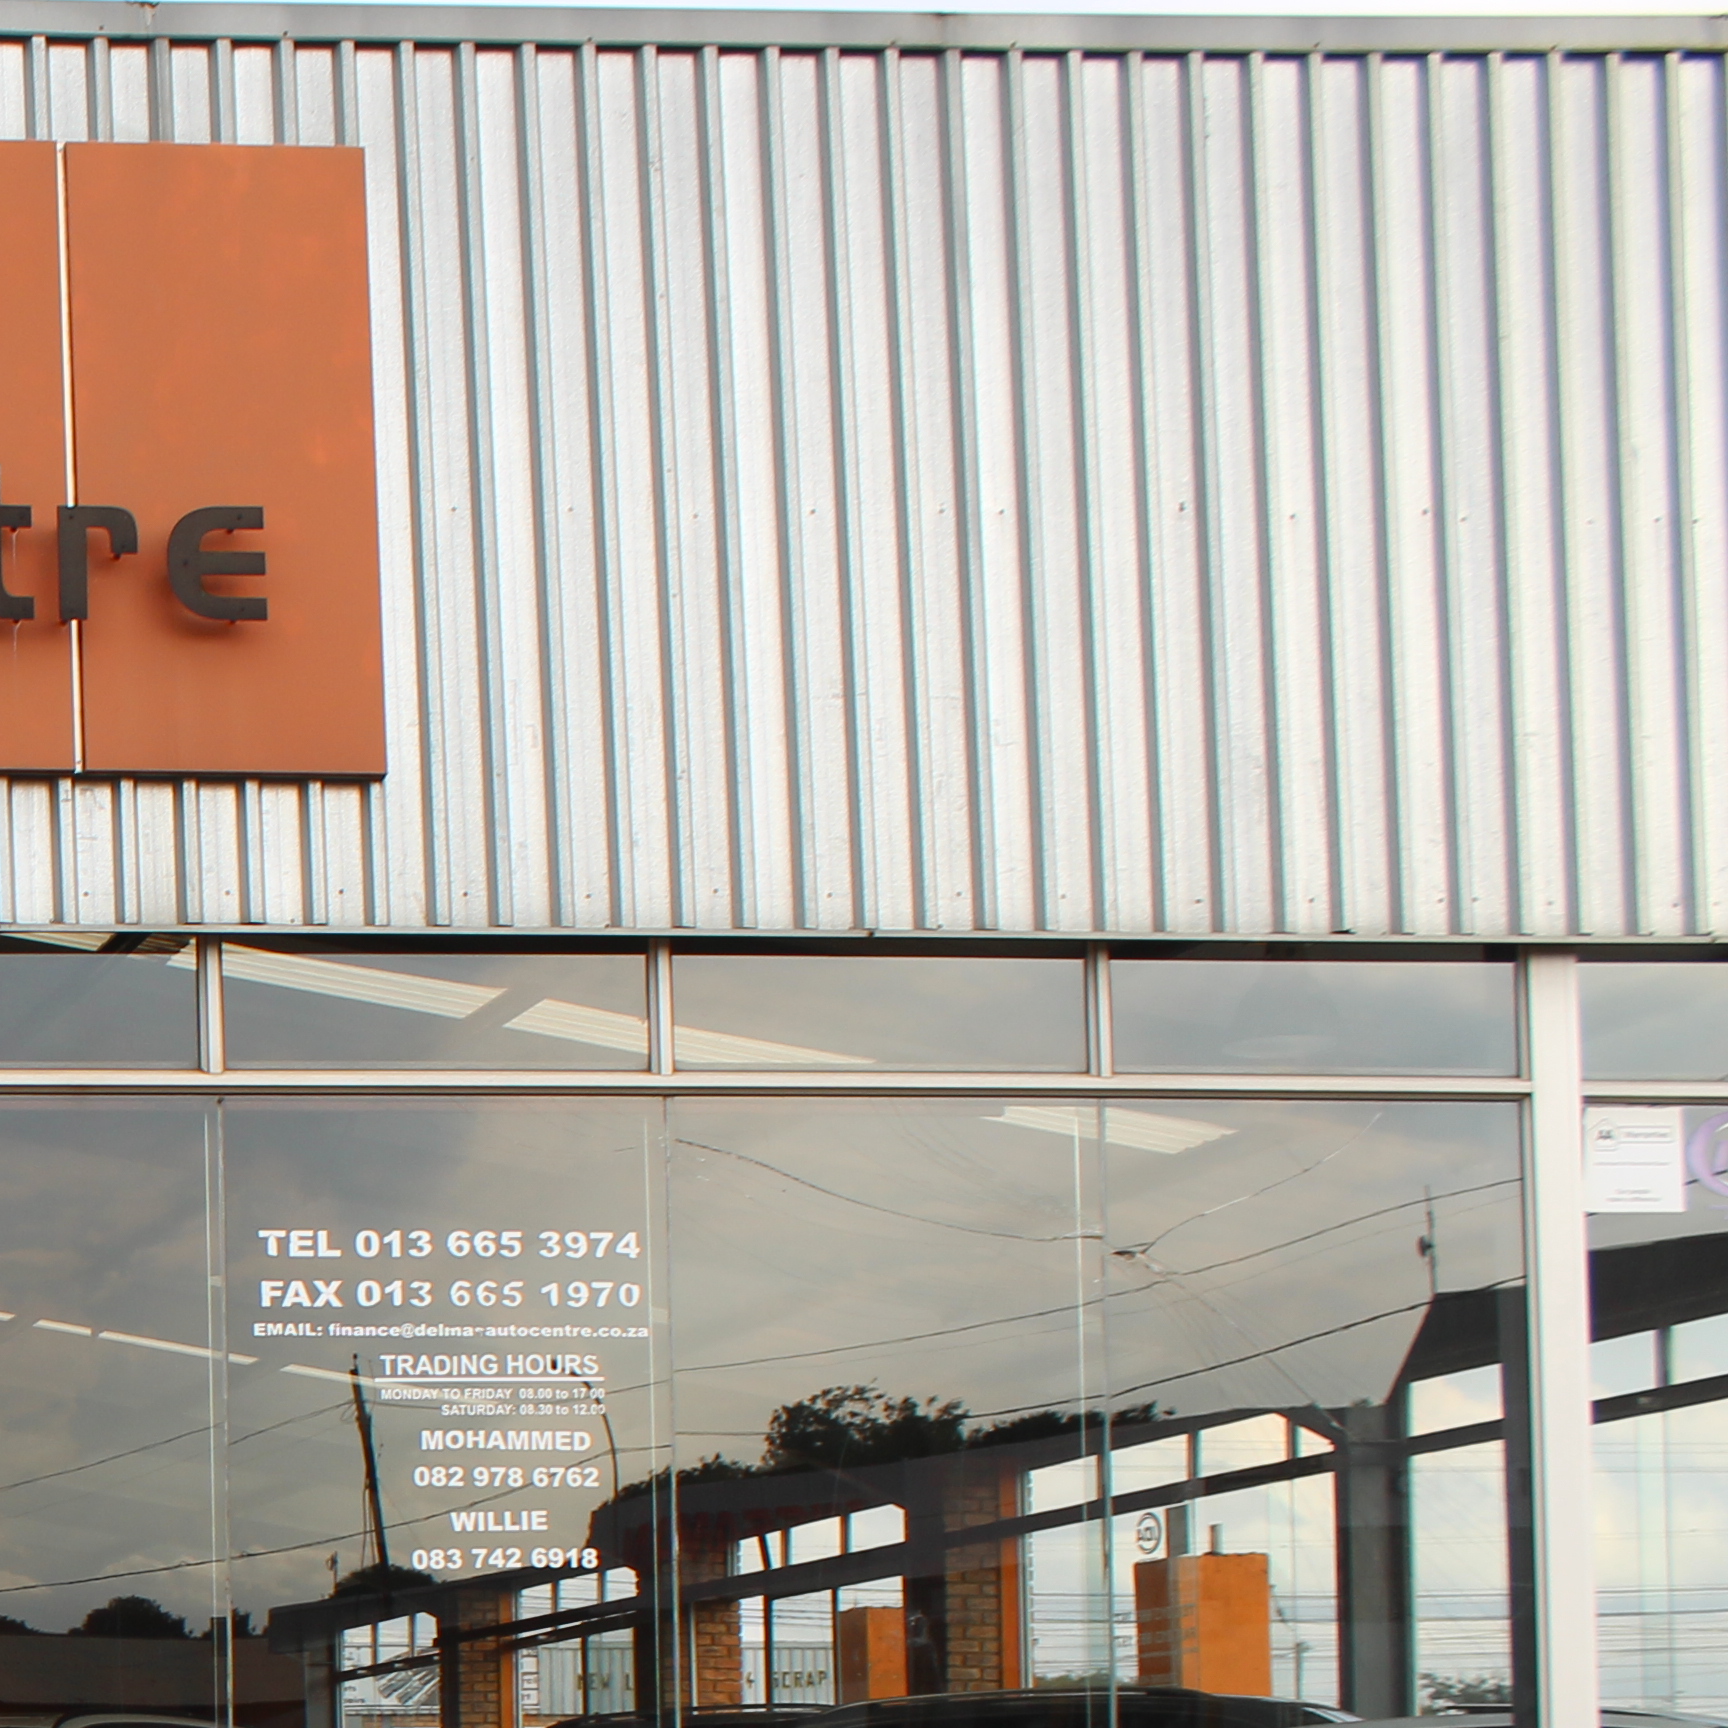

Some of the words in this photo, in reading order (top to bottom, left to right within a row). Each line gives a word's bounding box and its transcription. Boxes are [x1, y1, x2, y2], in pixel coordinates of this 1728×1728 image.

[258, 1230, 341, 1258] TEL
[356, 1230, 432, 1258] 013
[447, 1231, 522, 1258] 665
[539, 1231, 640, 1259] 3974
[260, 1280, 343, 1307] FAX
[357, 1280, 432, 1307] 013
[450, 1281, 523, 1307] 665
[541, 1282, 640, 1307] 1970
[253, 1323, 323, 1337] EMAIL:
[379, 1354, 498, 1375] TRADING
[507, 1354, 599, 1375] HOURS
[381, 1388, 438, 1400] MONDAY
[442, 1388, 461, 1400] TO
[464, 1388, 513, 1400] FRIDAY
[555, 1389, 569, 1400] to
[572, 1388, 606, 1400] 1700
[441, 1404, 516, 1416] SATURDAY:
[555, 1405, 569, 1416] to
[421, 1430, 591, 1451] MOHAMMED
[414, 1466, 464, 1487] 082
[473, 1466, 523, 1488] 978
[532, 1467, 599, 1488] 6762
[450, 1510, 548, 1532] WILLIE
[412, 1548, 462, 1570] 083
[472, 1547, 522, 1569] 742
[533, 1548, 598, 1569] 6918
